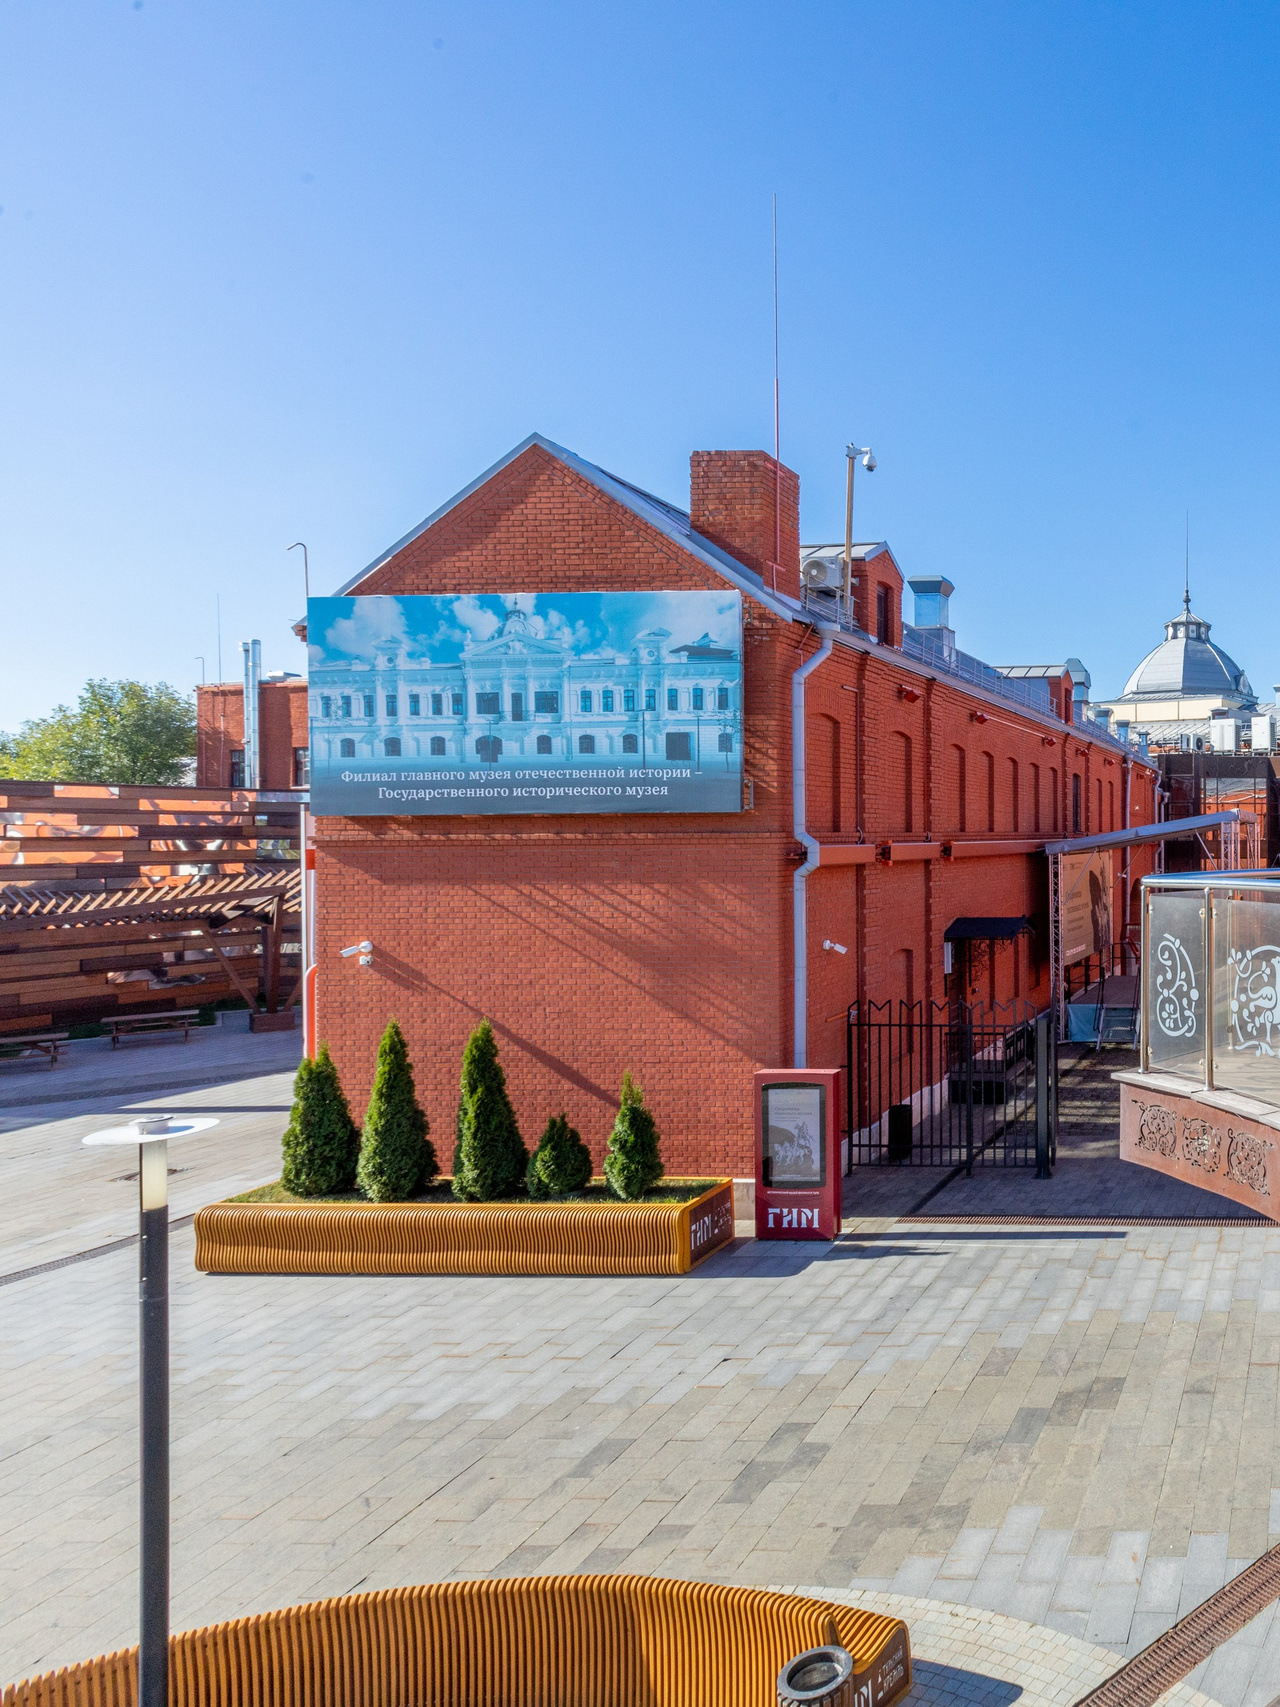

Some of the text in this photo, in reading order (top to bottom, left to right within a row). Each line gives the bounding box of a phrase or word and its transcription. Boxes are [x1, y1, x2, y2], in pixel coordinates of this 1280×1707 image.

[341, 770, 397, 782] Филиал
[401, 770, 465, 781] главного
[469, 769, 512, 783] музея
[515, 767, 626, 779] отечественной
[629, 768, 691, 781] истории
[378, 785, 669, 801] Государственного исторического музея
[767, 1208, 820, 1228] ГИМ
